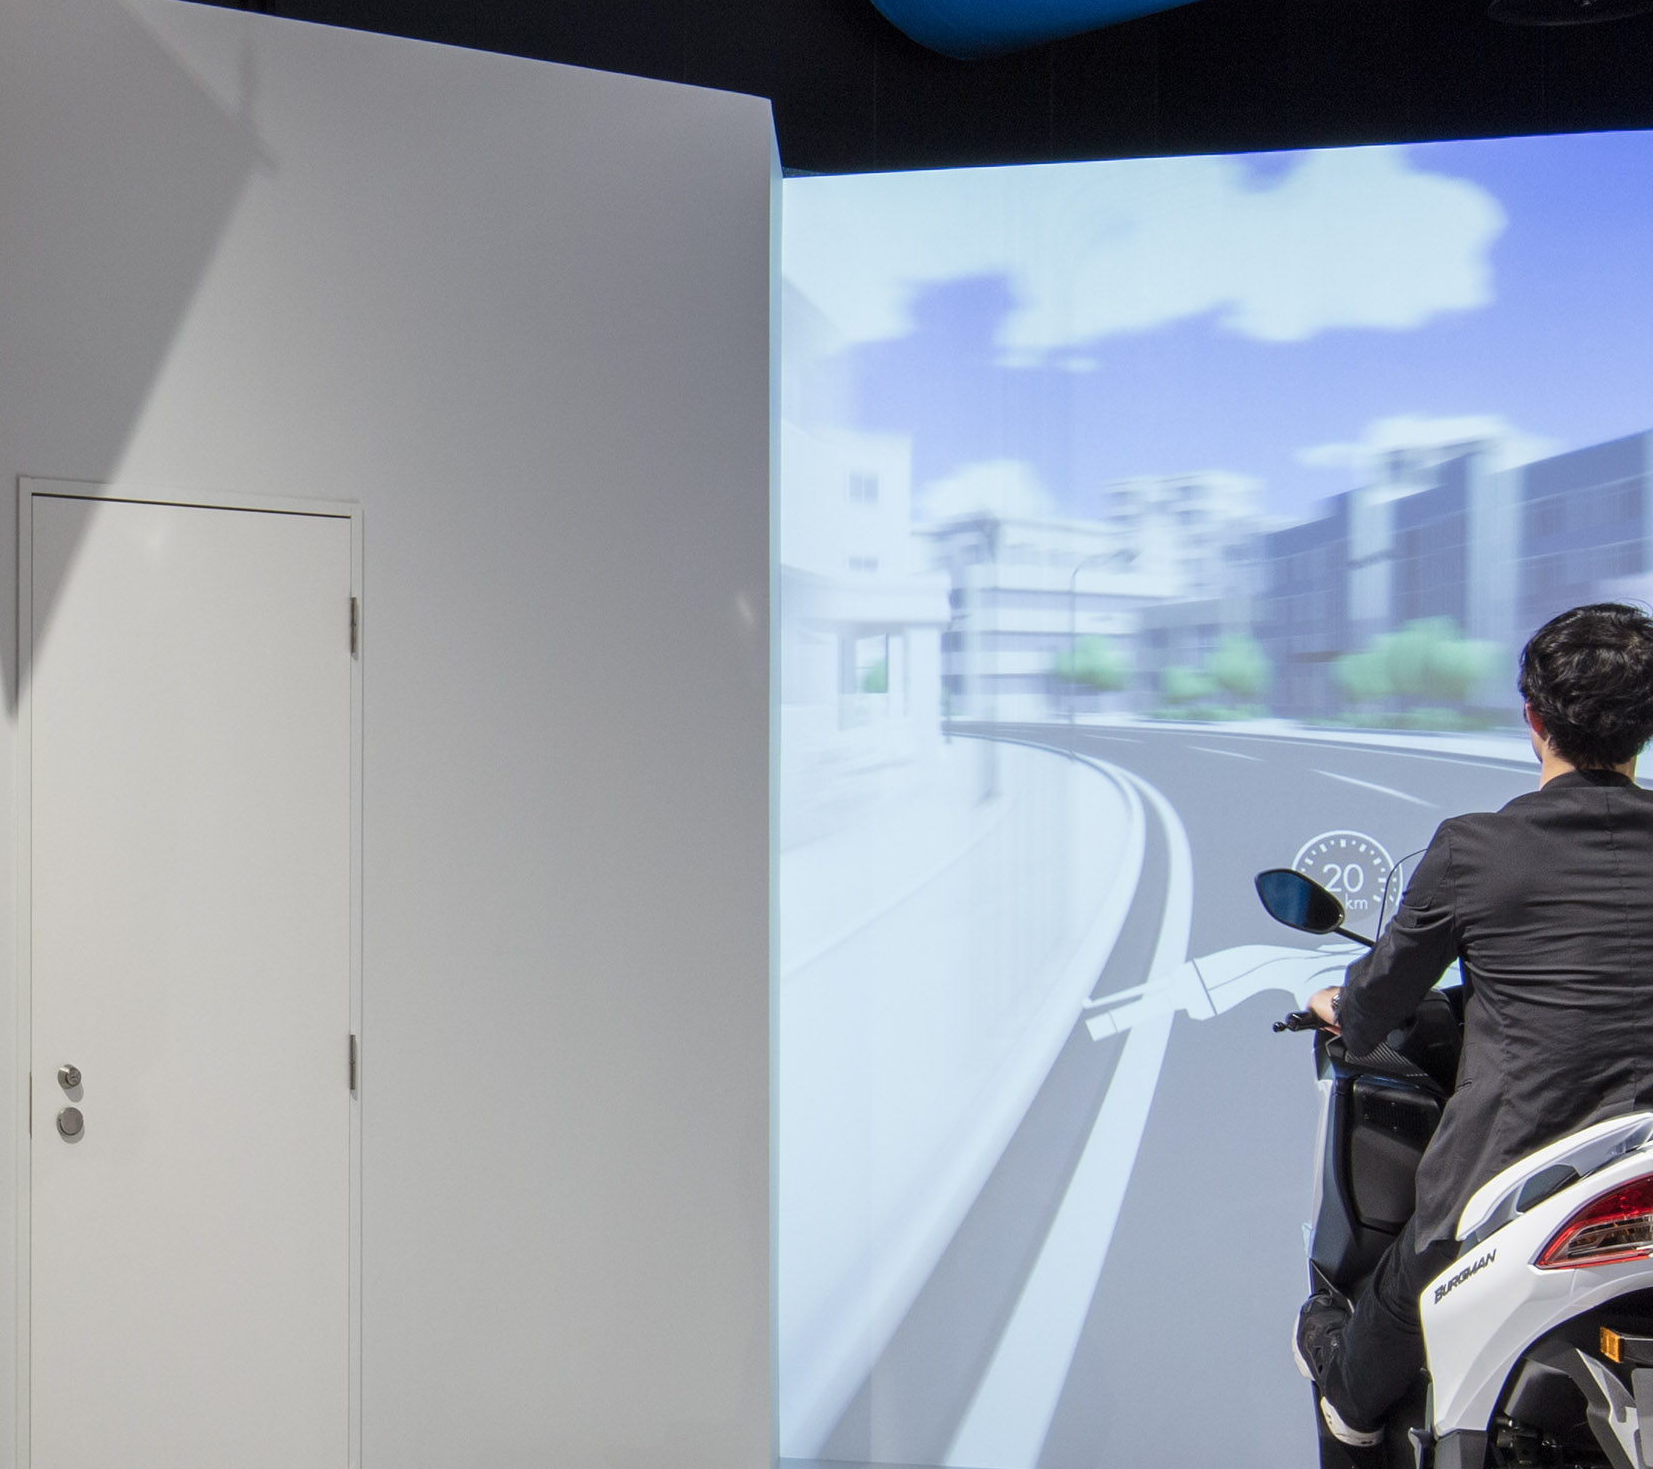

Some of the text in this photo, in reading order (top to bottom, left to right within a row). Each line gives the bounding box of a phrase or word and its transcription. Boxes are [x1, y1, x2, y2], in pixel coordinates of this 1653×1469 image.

[1322, 863, 1364, 893] 20
[1344, 892, 1369, 910] km
[1434, 1248, 1497, 1305] BURGMAN
